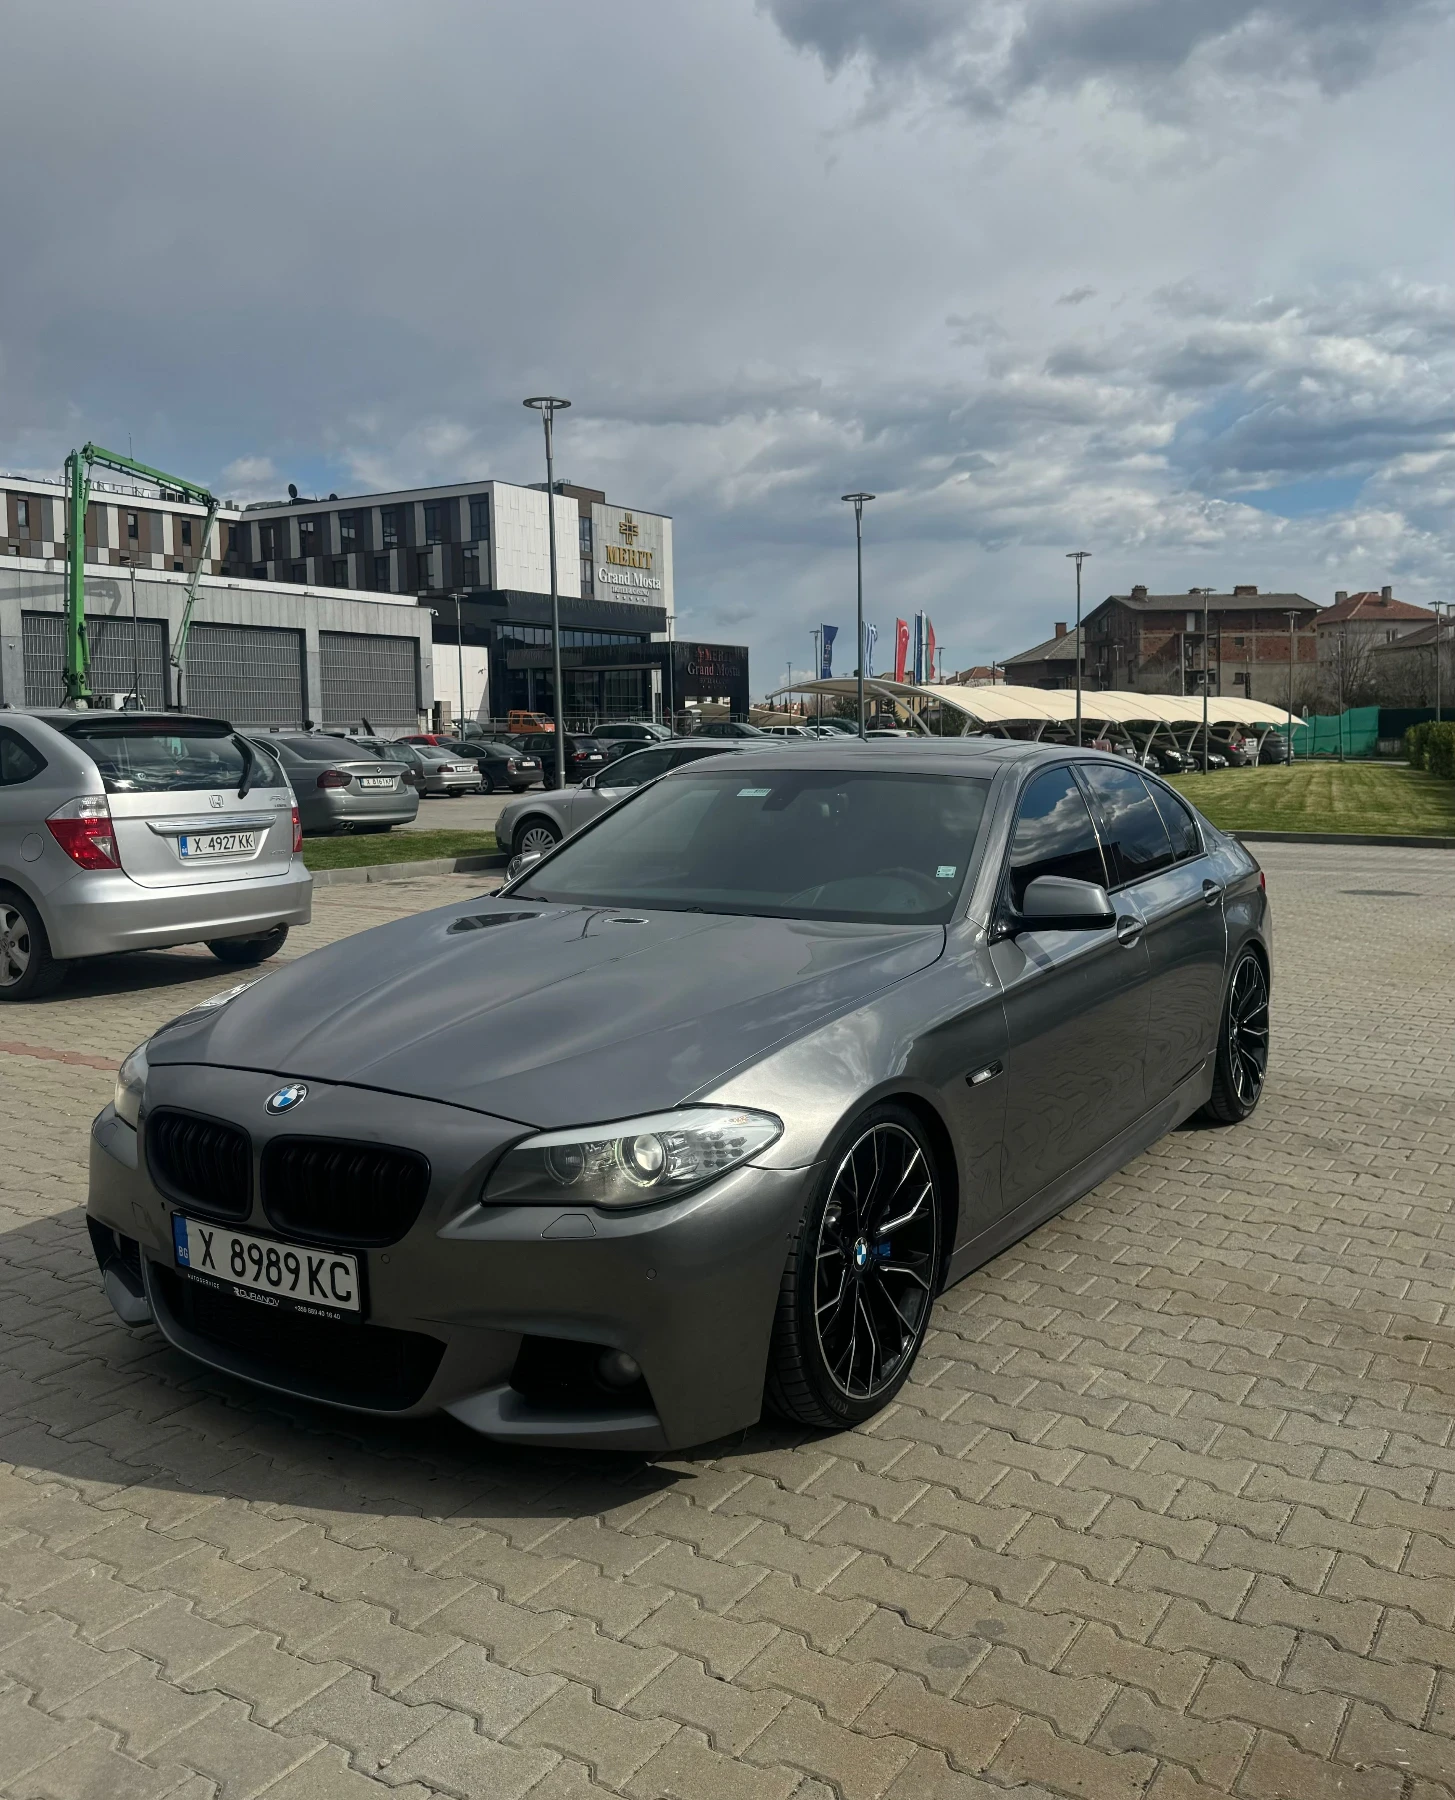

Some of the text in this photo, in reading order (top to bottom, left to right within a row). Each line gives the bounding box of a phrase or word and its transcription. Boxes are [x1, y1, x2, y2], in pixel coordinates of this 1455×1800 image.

[605, 544, 653, 570] MERIT
[598, 567, 661, 590] Grand Mosta
[687, 661, 741, 677] Grand Mosta
[194, 833, 253, 853] X 4927 KK
[178, 1245, 189, 1259] BG
[199, 1228, 352, 1302] X 8989 KC
[187, 1273, 220, 1290] AUTOSERVICE
